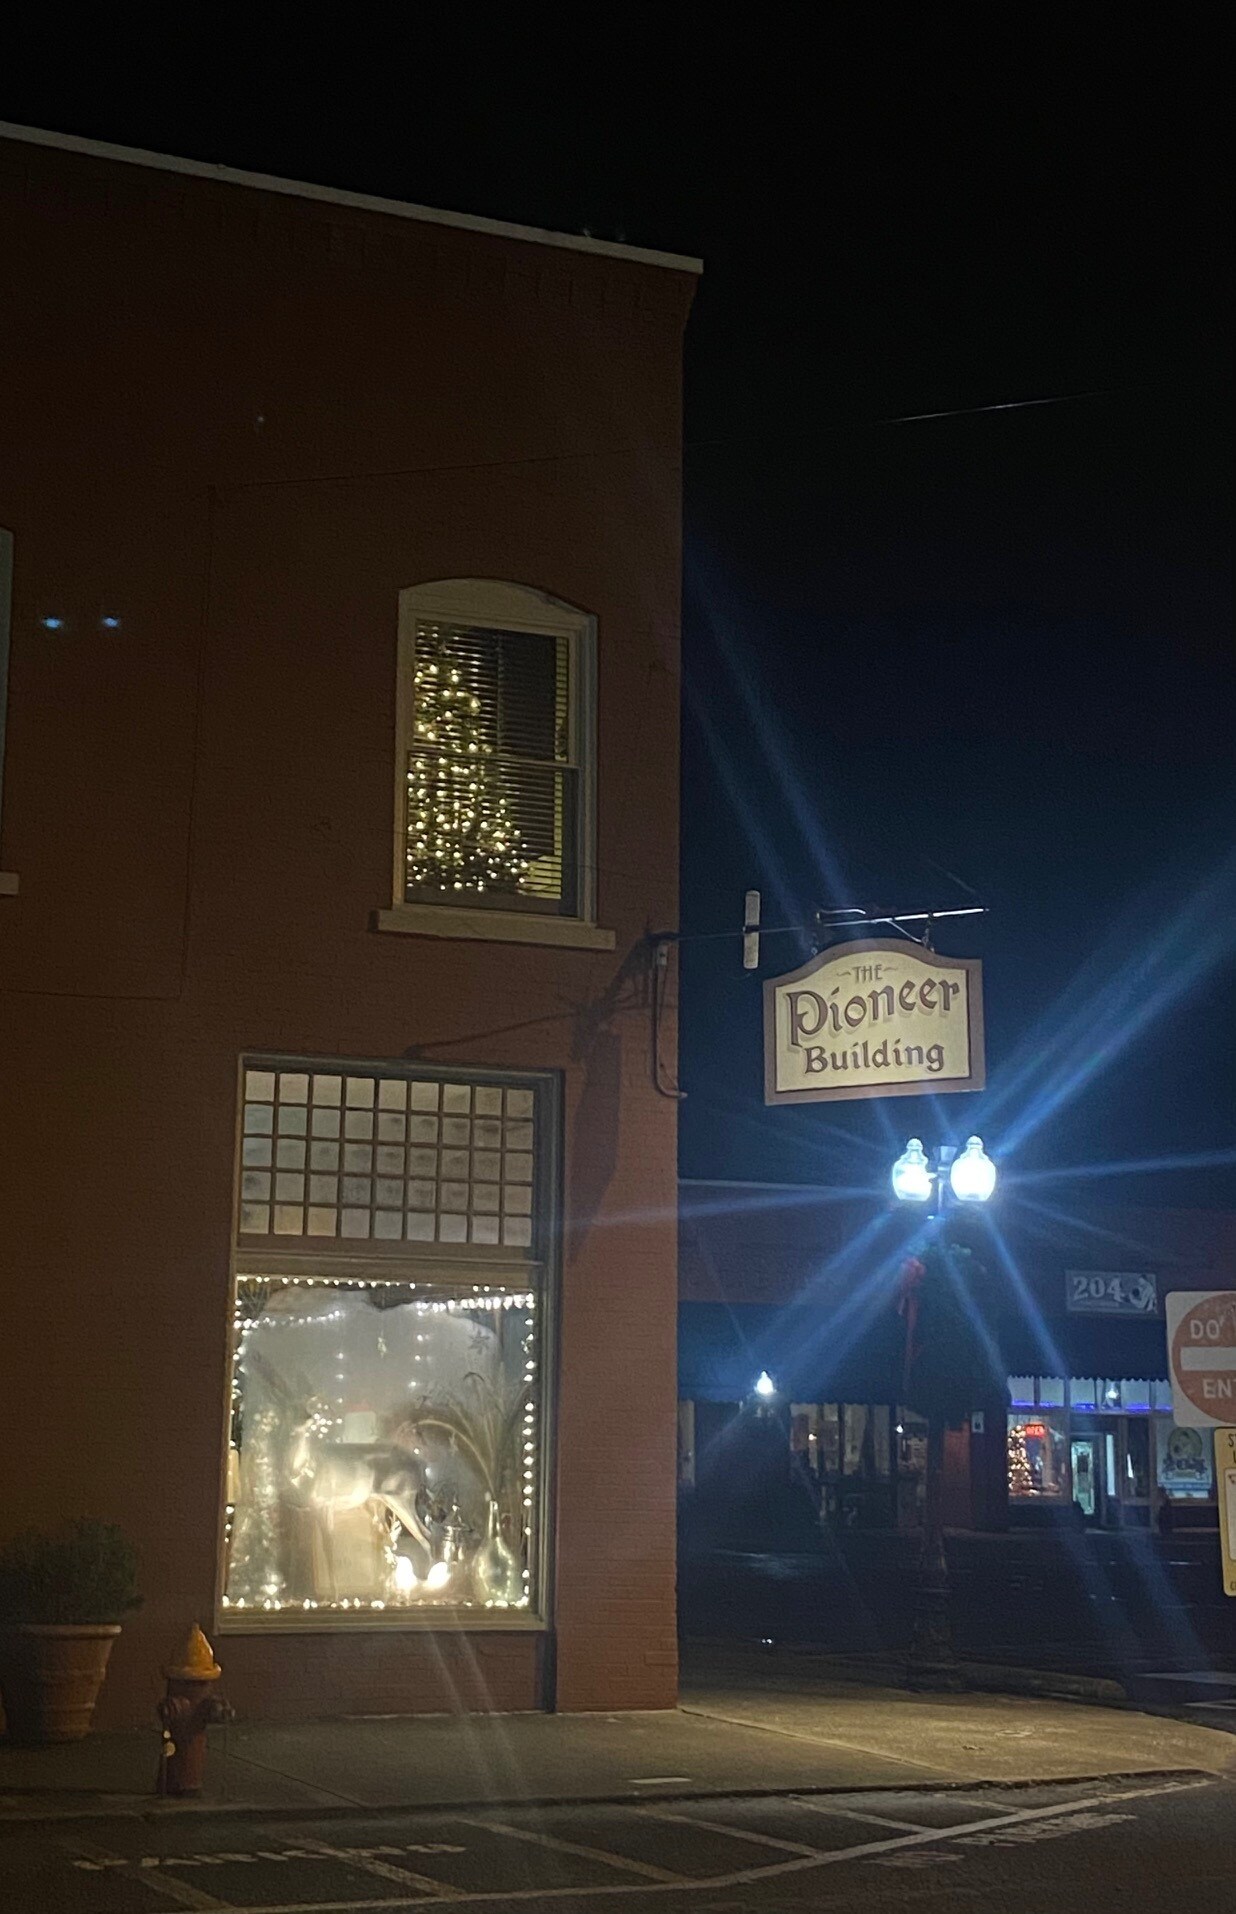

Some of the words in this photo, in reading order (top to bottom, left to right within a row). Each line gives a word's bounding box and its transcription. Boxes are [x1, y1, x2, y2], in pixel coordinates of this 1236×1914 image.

[852, 964, 883, 984] THE
[786, 977, 961, 1048] Pioneer
[803, 1038, 945, 1075] Building
[1189, 1319, 1220, 1340] DO
[1202, 1378, 1236, 1399] EN
